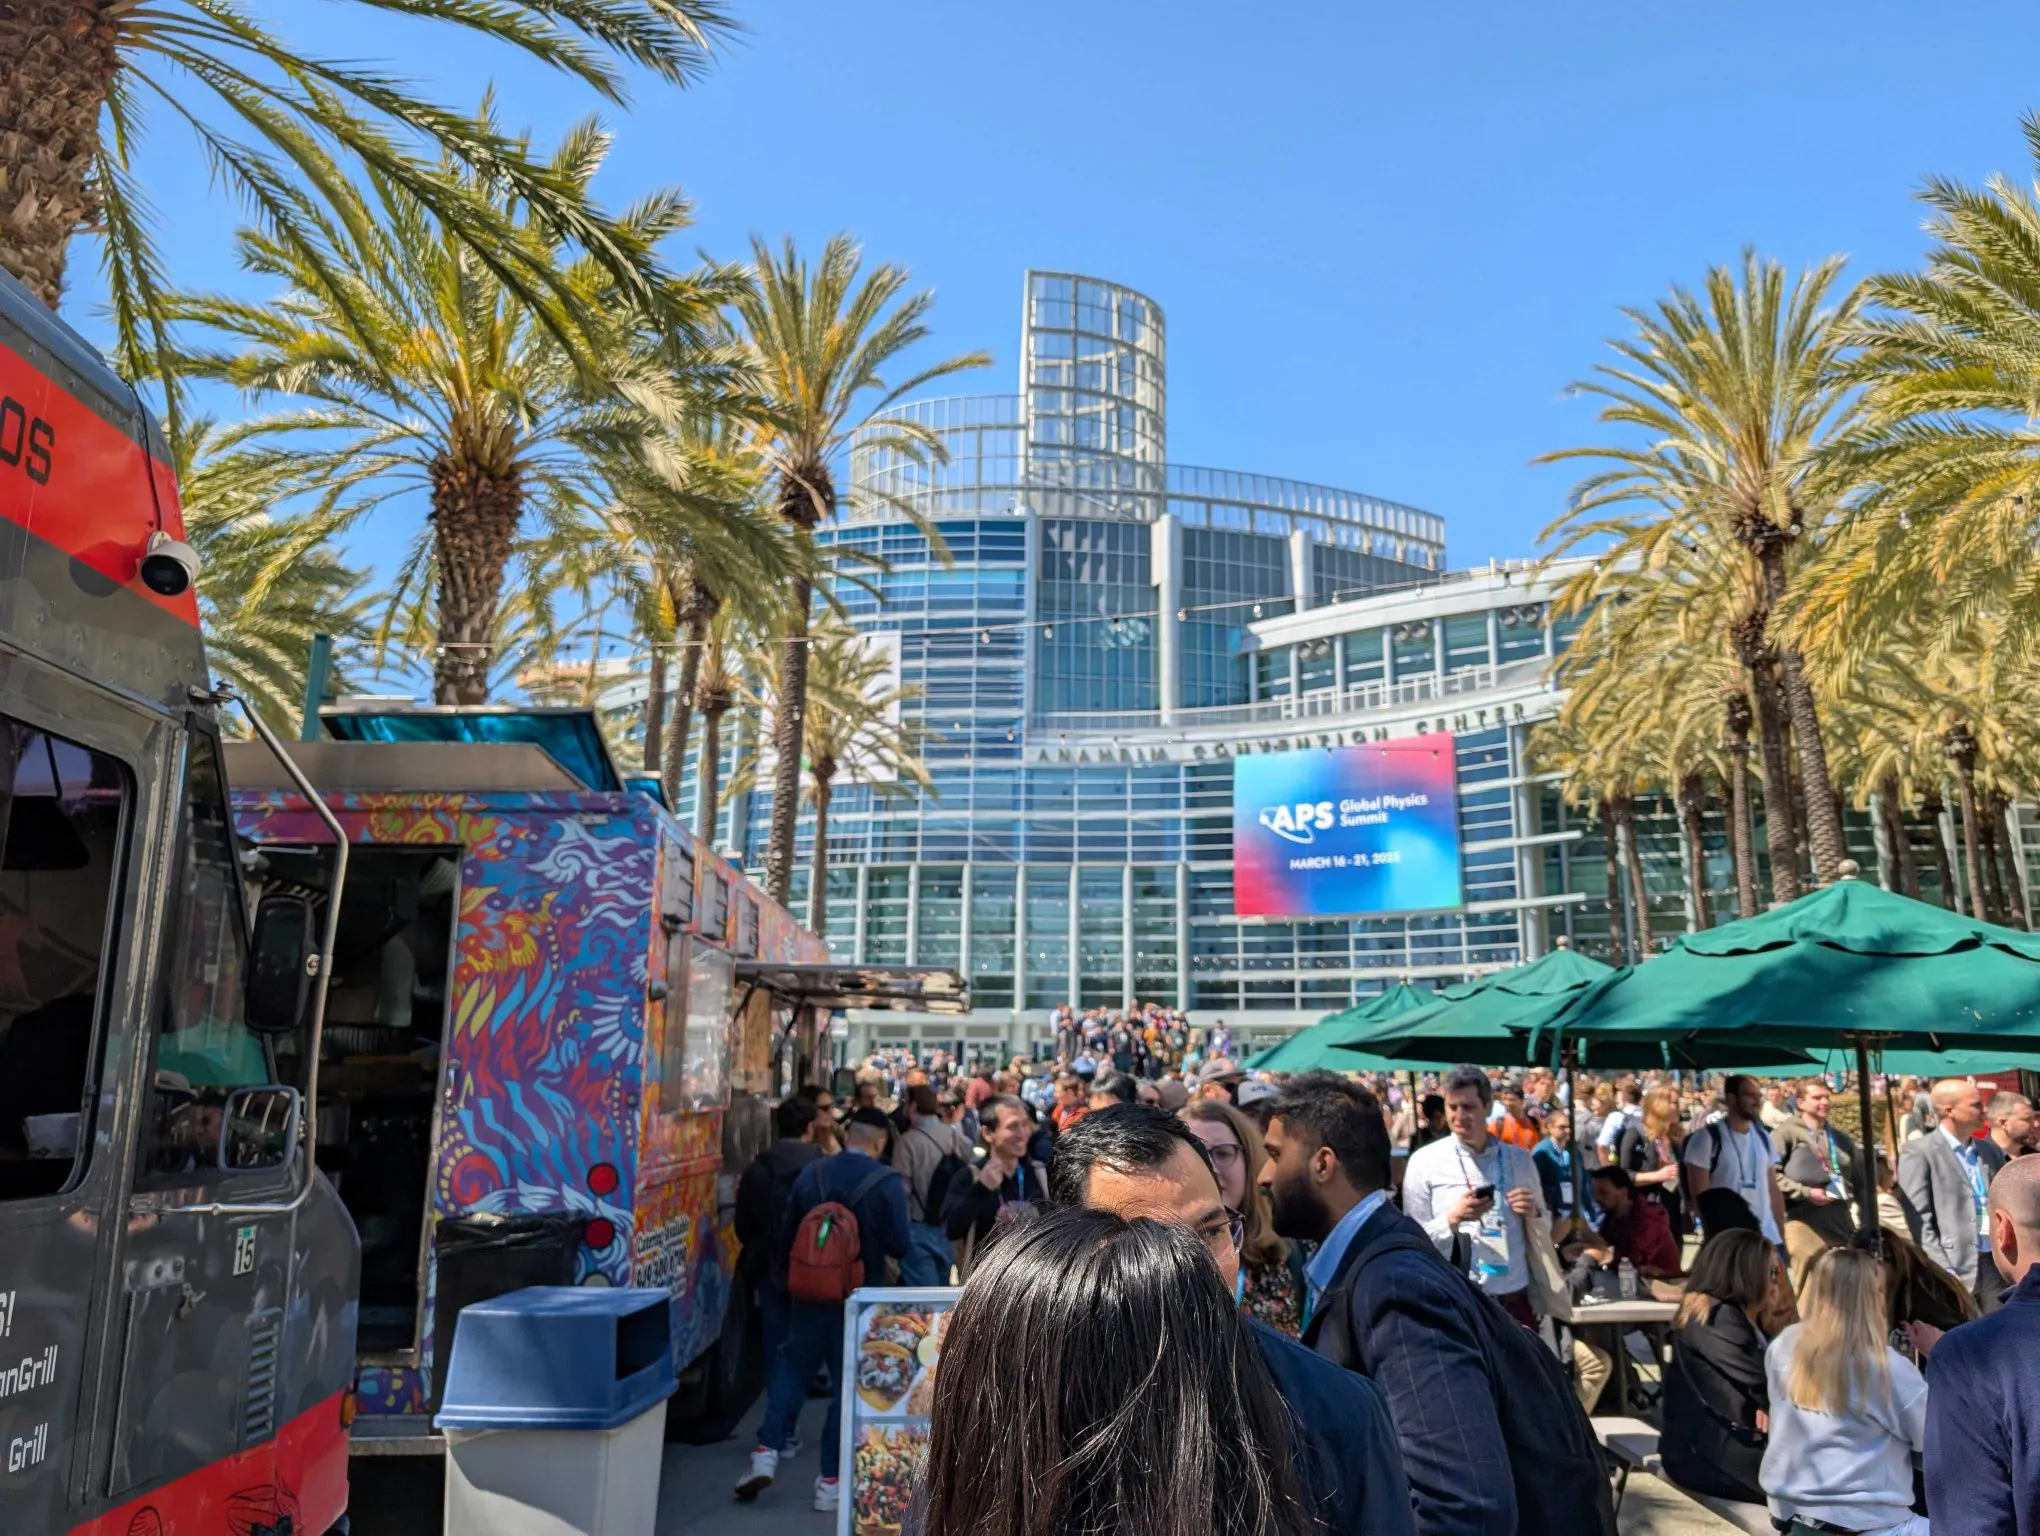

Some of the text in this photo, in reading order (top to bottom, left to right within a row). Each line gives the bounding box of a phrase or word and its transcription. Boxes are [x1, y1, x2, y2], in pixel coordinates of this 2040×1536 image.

[1037, 702, 1525, 765] ANAHEIM CONVENTION CENTER
[1273, 801, 1335, 832] APS
[1339, 794, 1429, 813] Global Physics
[1339, 811, 1389, 827] Summit
[1289, 855, 1332, 870] MARCH
[1333, 855, 1346, 868] 16
[237, 1238, 254, 1272] 15
[8, 1422, 49, 1473] Grill
